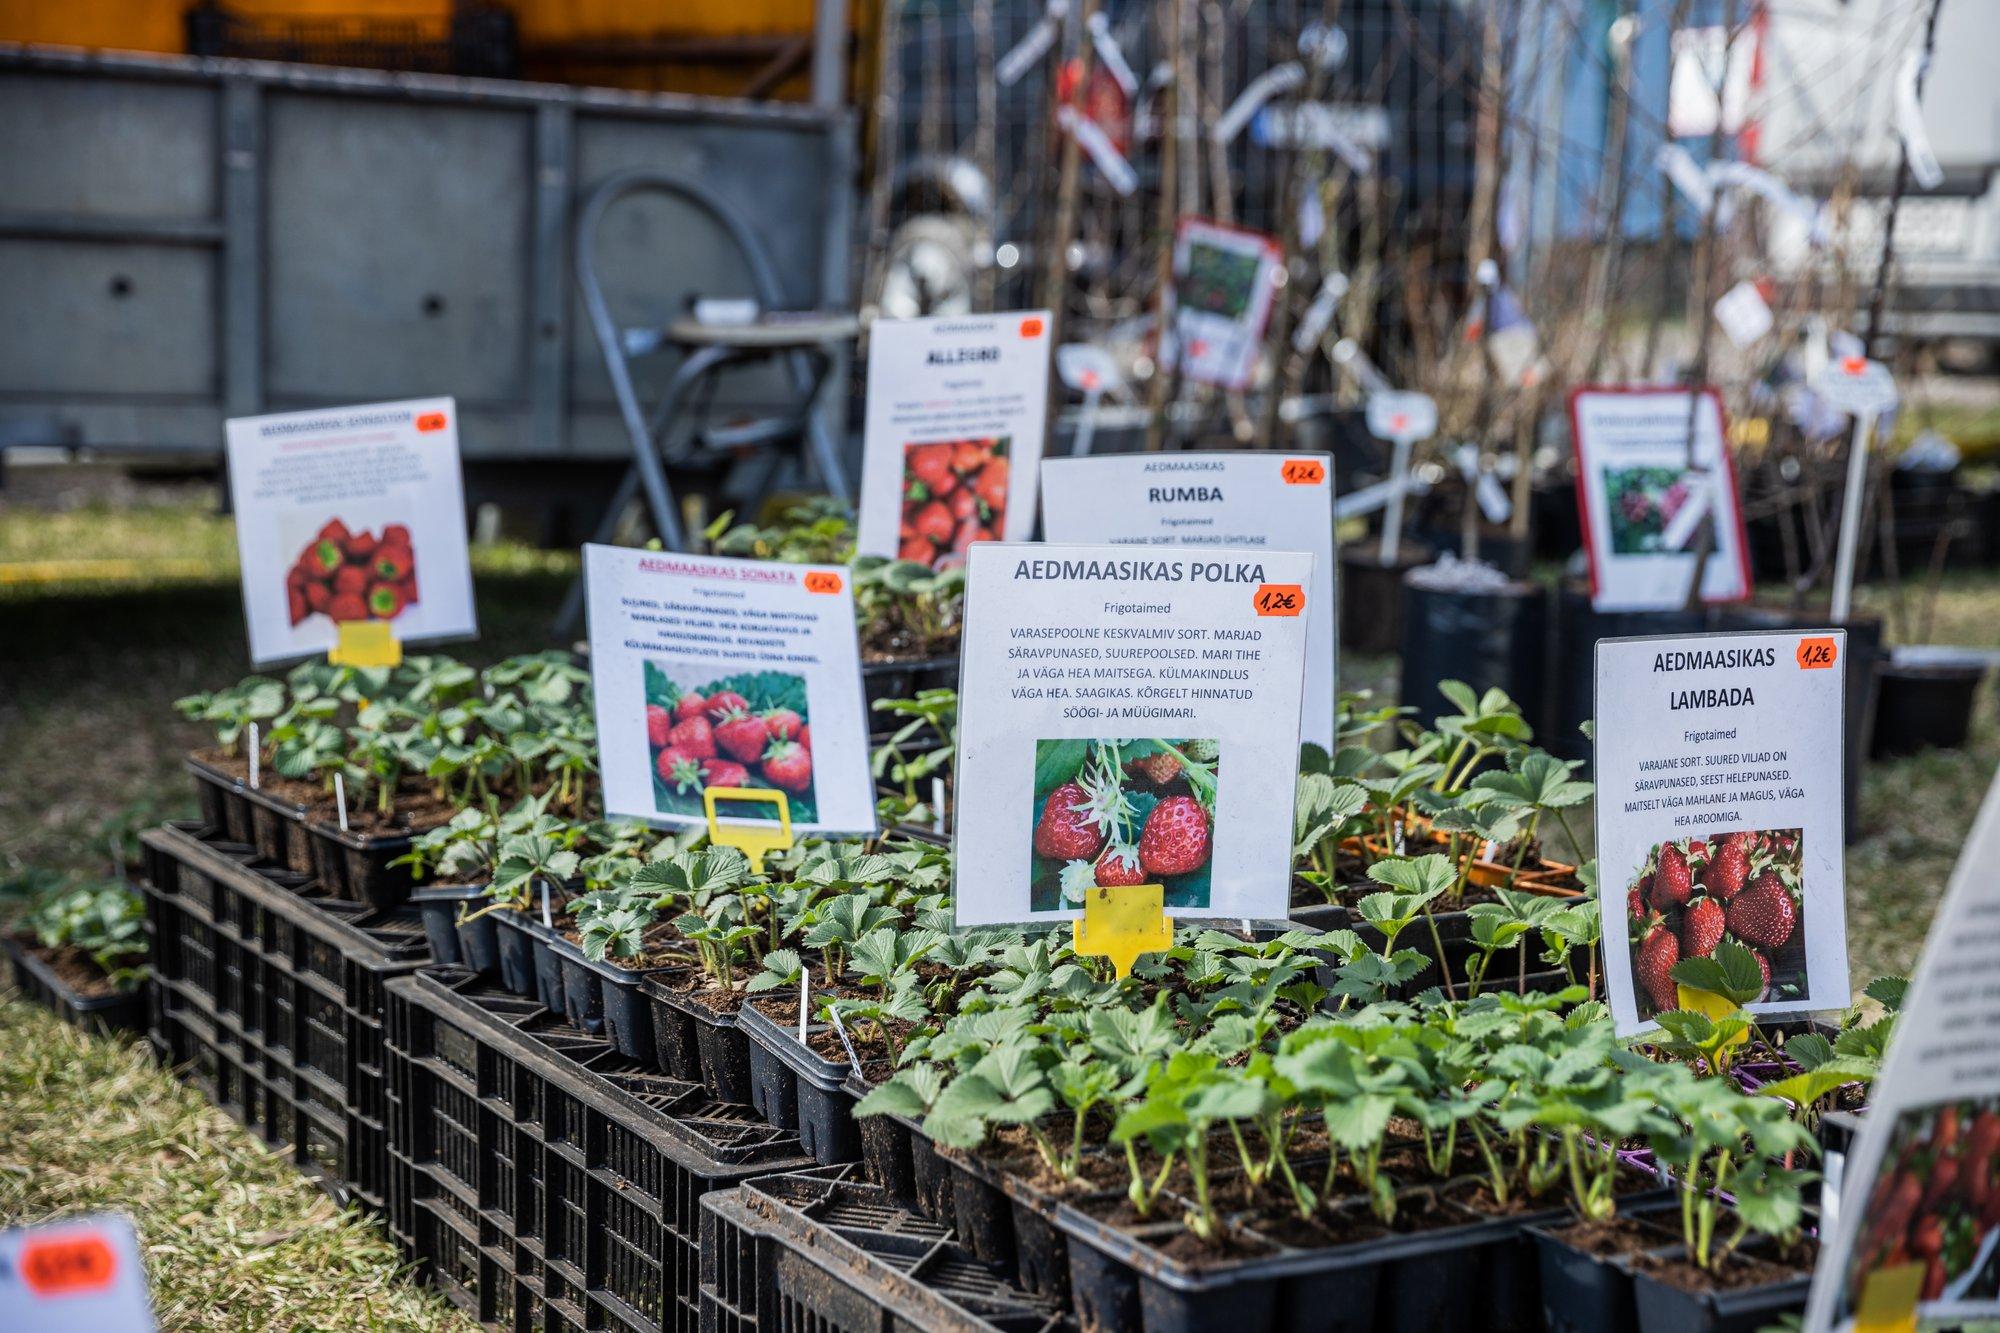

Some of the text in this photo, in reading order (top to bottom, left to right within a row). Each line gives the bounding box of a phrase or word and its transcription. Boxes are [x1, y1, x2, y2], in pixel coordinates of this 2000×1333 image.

[1144, 461, 1225, 473] AEDMAASIKAS
[1149, 487, 1224, 502] RUMBA
[740, 569, 796, 583] SONATA
[1014, 560, 1266, 583] AEDMAASIKAS POLKA
[1104, 602, 1171, 615] Frigotaimed
[1259, 592, 1296, 612] 1,2€
[1010, 627, 1262, 641] VARASEPOOLNE KESKVALMIV SORT. MARJAD
[1008, 646, 1261, 661] SÄRAVPUNASED, SUUREPOOLSED. MARI TIHE
[1653, 648, 1775, 672] AEDMAASIKAS
[1802, 645, 1831, 663] 1,2€
[1017, 665, 1249, 680] JA VÄGA HEA MAITSEGA. KÜLMAKINDLUS
[1011, 685, 1253, 700] VÄGA HEA. SAAGIKAS. KÕRGELT HINNATUD
[1670, 687, 1754, 710] LAMBADA
[1063, 705, 1196, 719] SÖÖGI- JA MÜÜGIMARI.
[1684, 728, 1736, 743] Frigotaimed
[1639, 751, 1787, 771] VARAJANE SORT. SUURED VILJAD ON
[1634, 770, 1792, 792] SÄRAVPUNASED, SEEST HELEPUNASED.
[1624, 786, 1805, 813] MAITSELT VÄGA MAHLANE JA MAGUS, VÄGA
[1674, 811, 1742, 827] HEA AROOMIGA.
